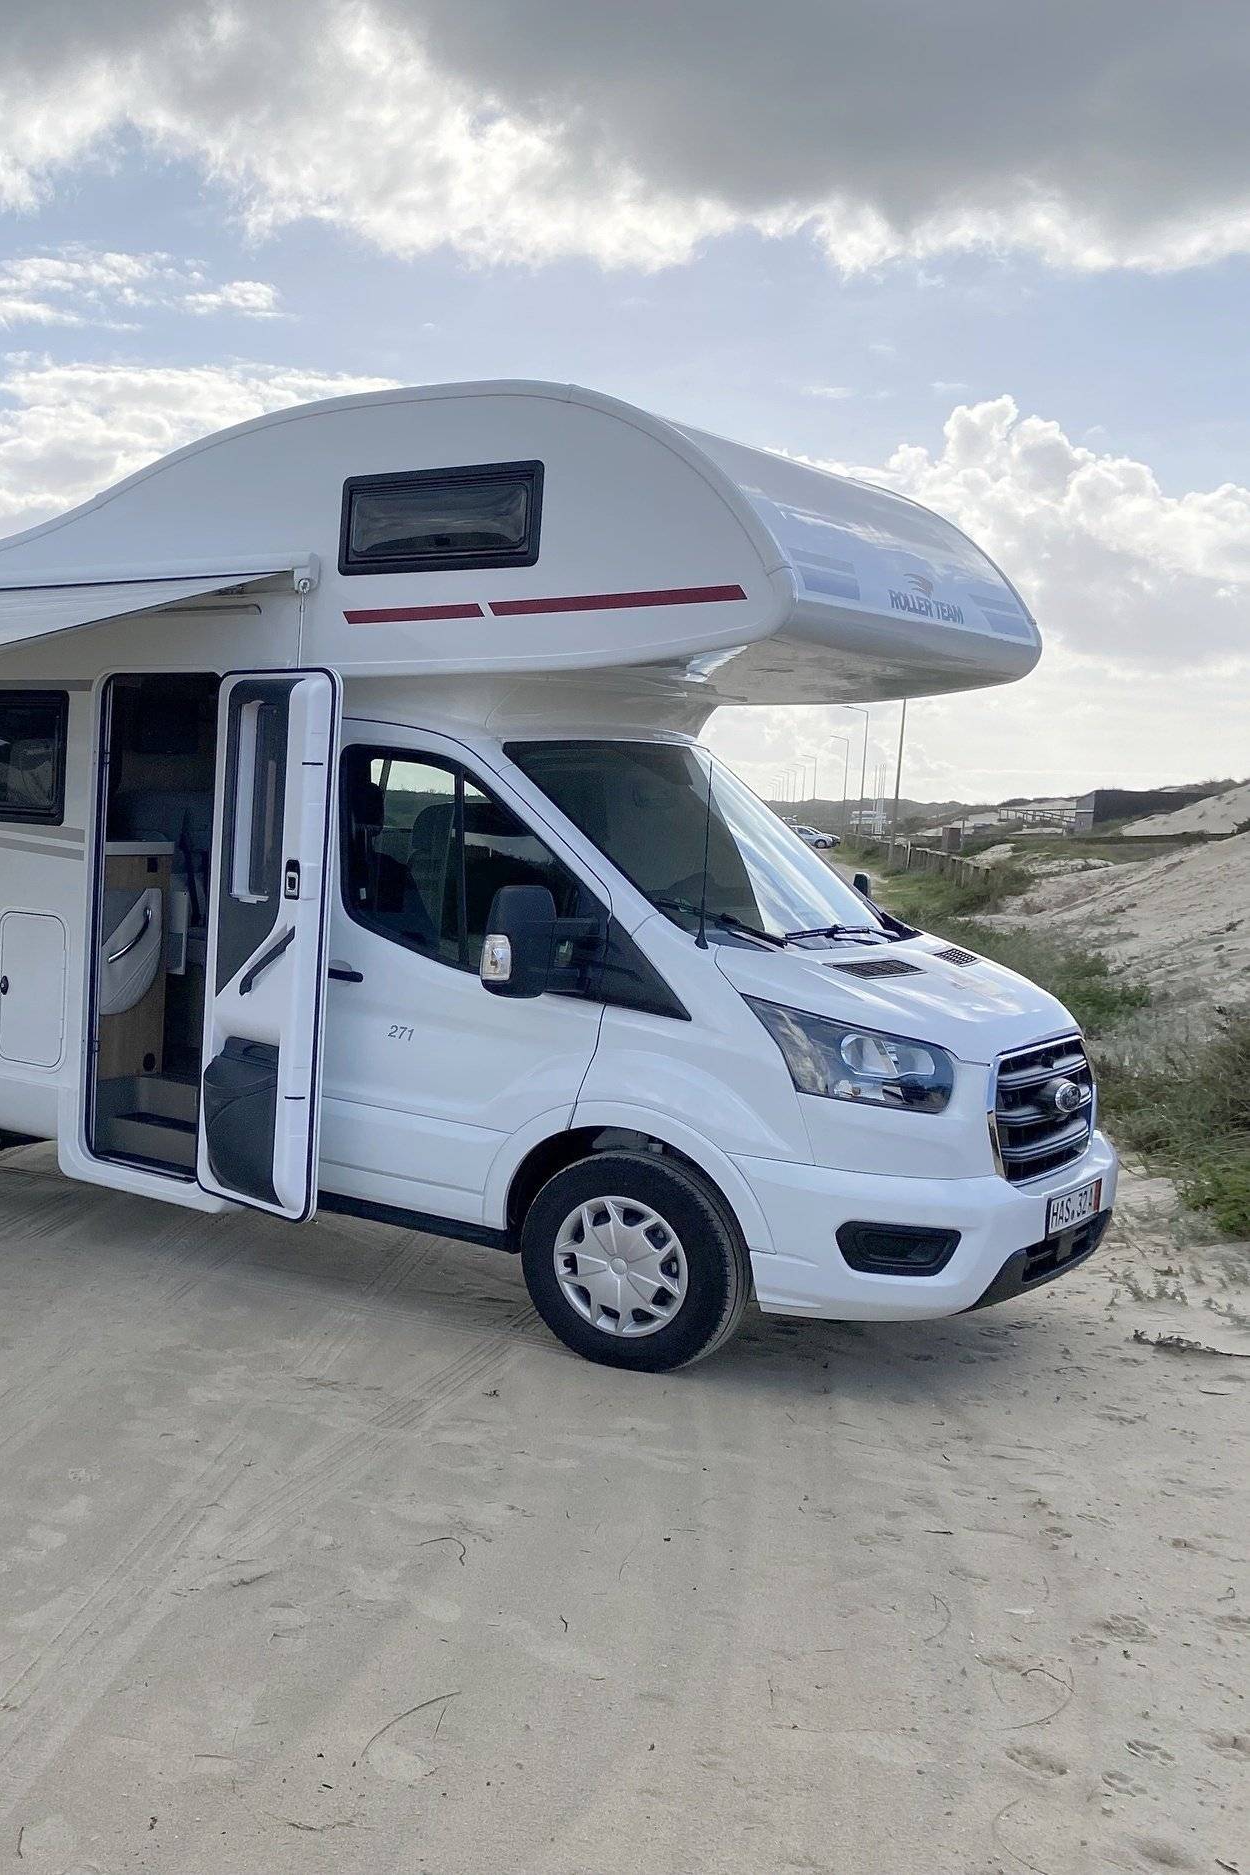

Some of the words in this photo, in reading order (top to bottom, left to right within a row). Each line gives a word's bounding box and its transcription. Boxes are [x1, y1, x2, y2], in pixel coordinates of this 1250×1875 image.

[888, 589, 934, 617] ROLLER
[933, 600, 964, 625] TEAM
[387, 1024, 415, 1042] 271
